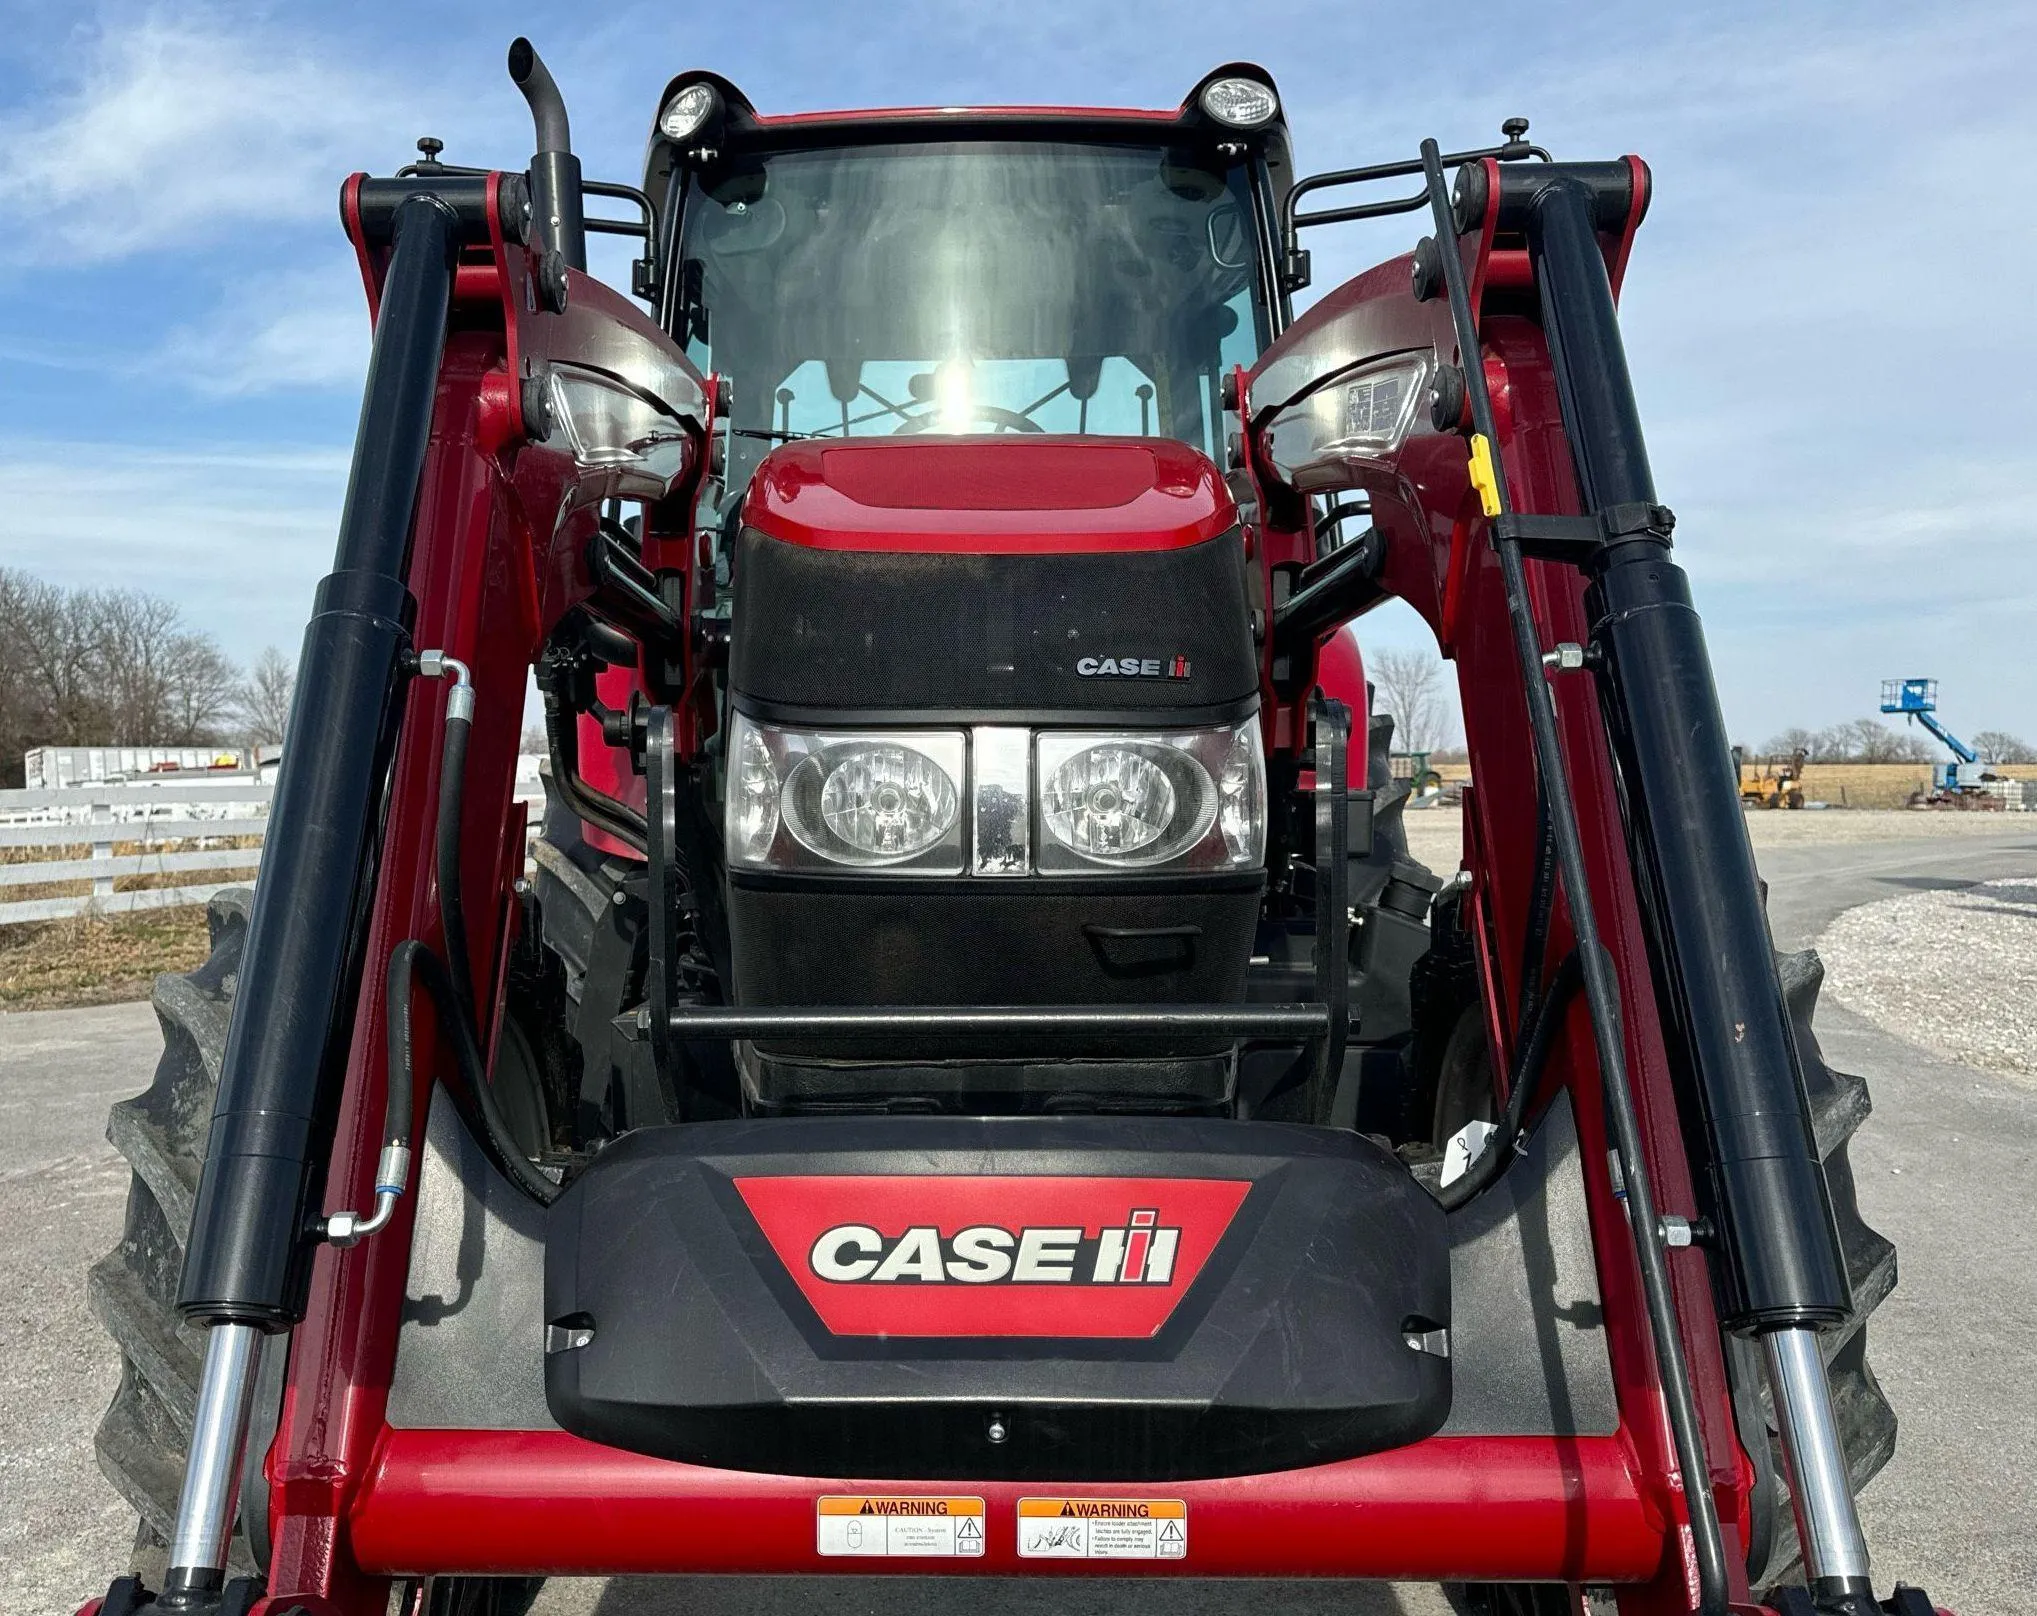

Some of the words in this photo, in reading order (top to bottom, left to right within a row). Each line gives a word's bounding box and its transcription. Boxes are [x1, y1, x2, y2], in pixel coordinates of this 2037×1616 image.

[1076, 657, 1161, 676] CASE
[811, 1224, 1084, 1283] CASE
[876, 1501, 948, 1515] WARNING
[1076, 1503, 1149, 1517] WARNING
